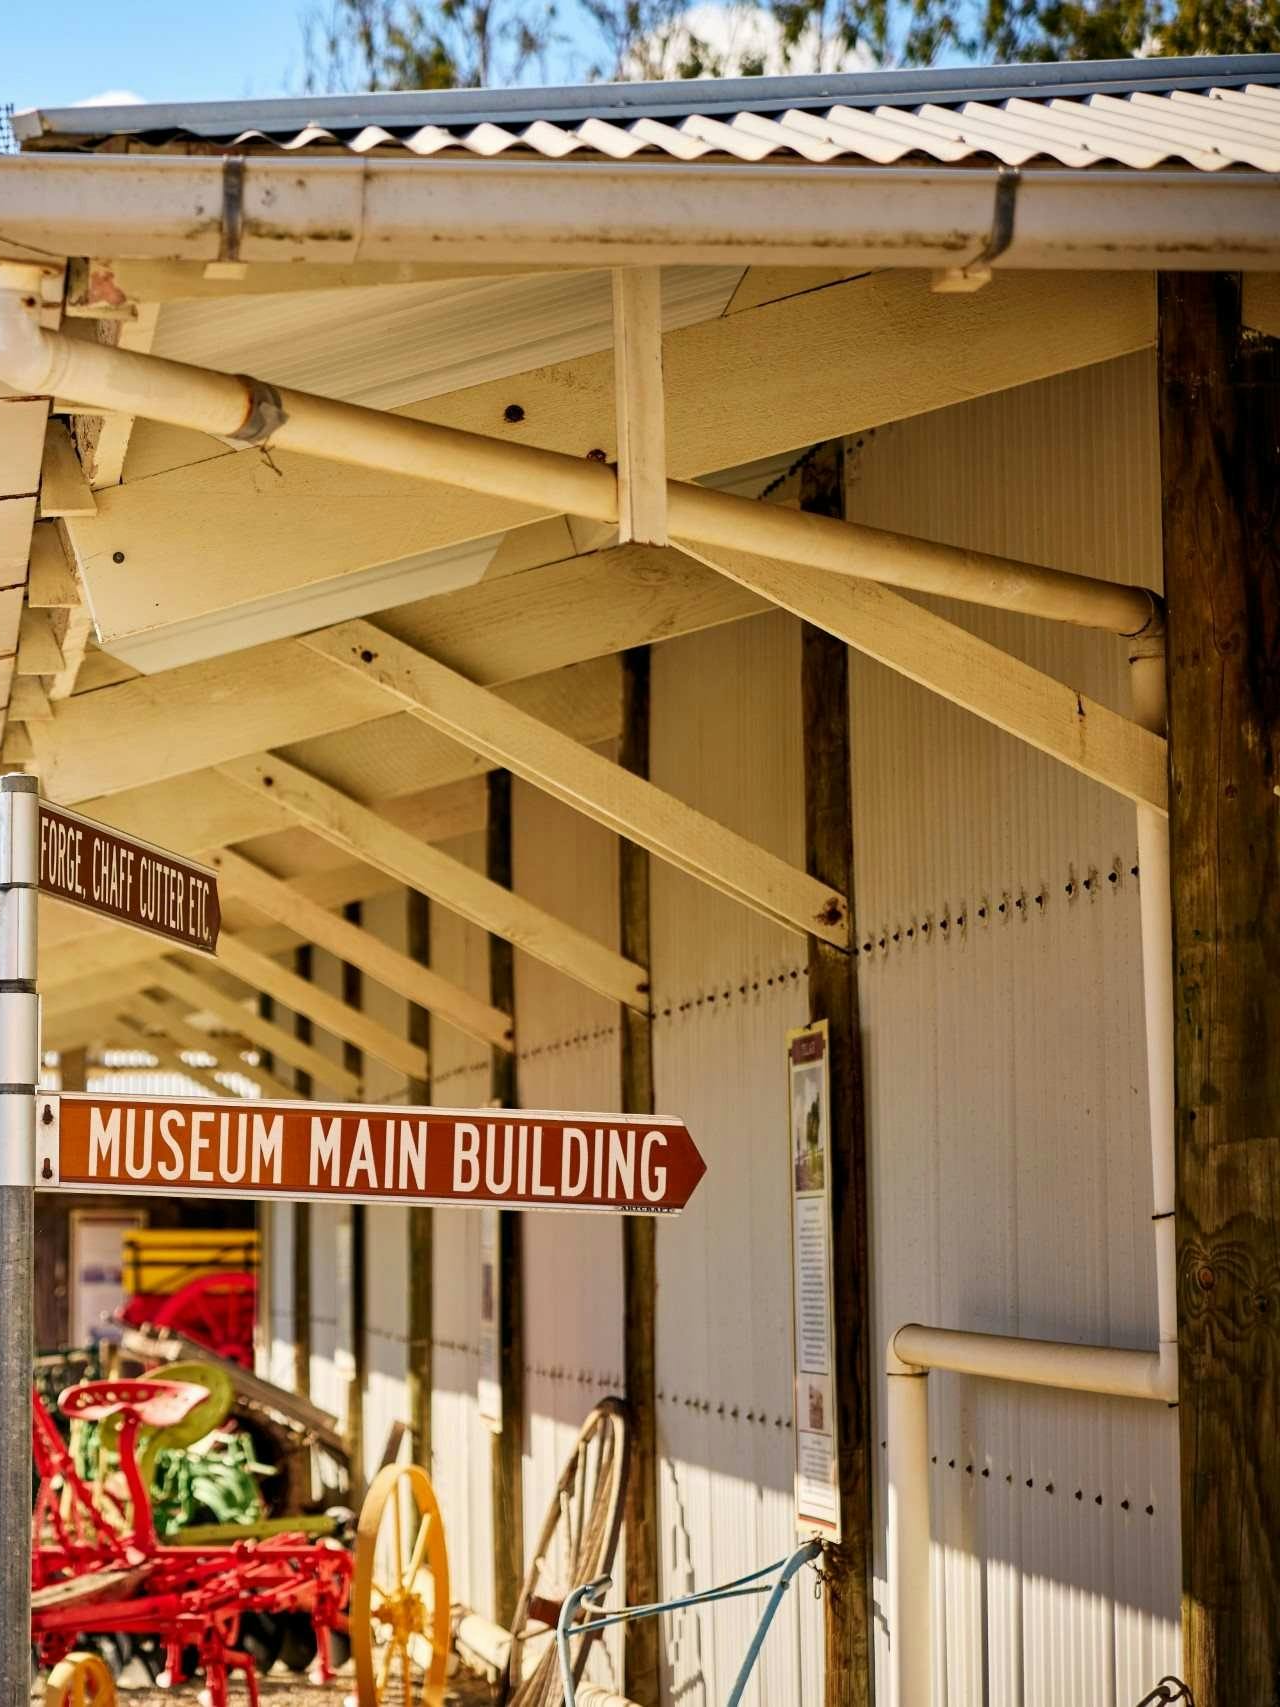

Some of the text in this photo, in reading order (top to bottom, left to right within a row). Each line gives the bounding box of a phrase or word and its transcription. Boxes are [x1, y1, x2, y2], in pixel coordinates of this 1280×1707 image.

[40, 816, 86, 899] FORGE,
[93, 837, 134, 912] CHAFF
[139, 856, 184, 932] CUTTER
[88, 1107, 668, 1202] MUSEUM MAIN BUILDING
